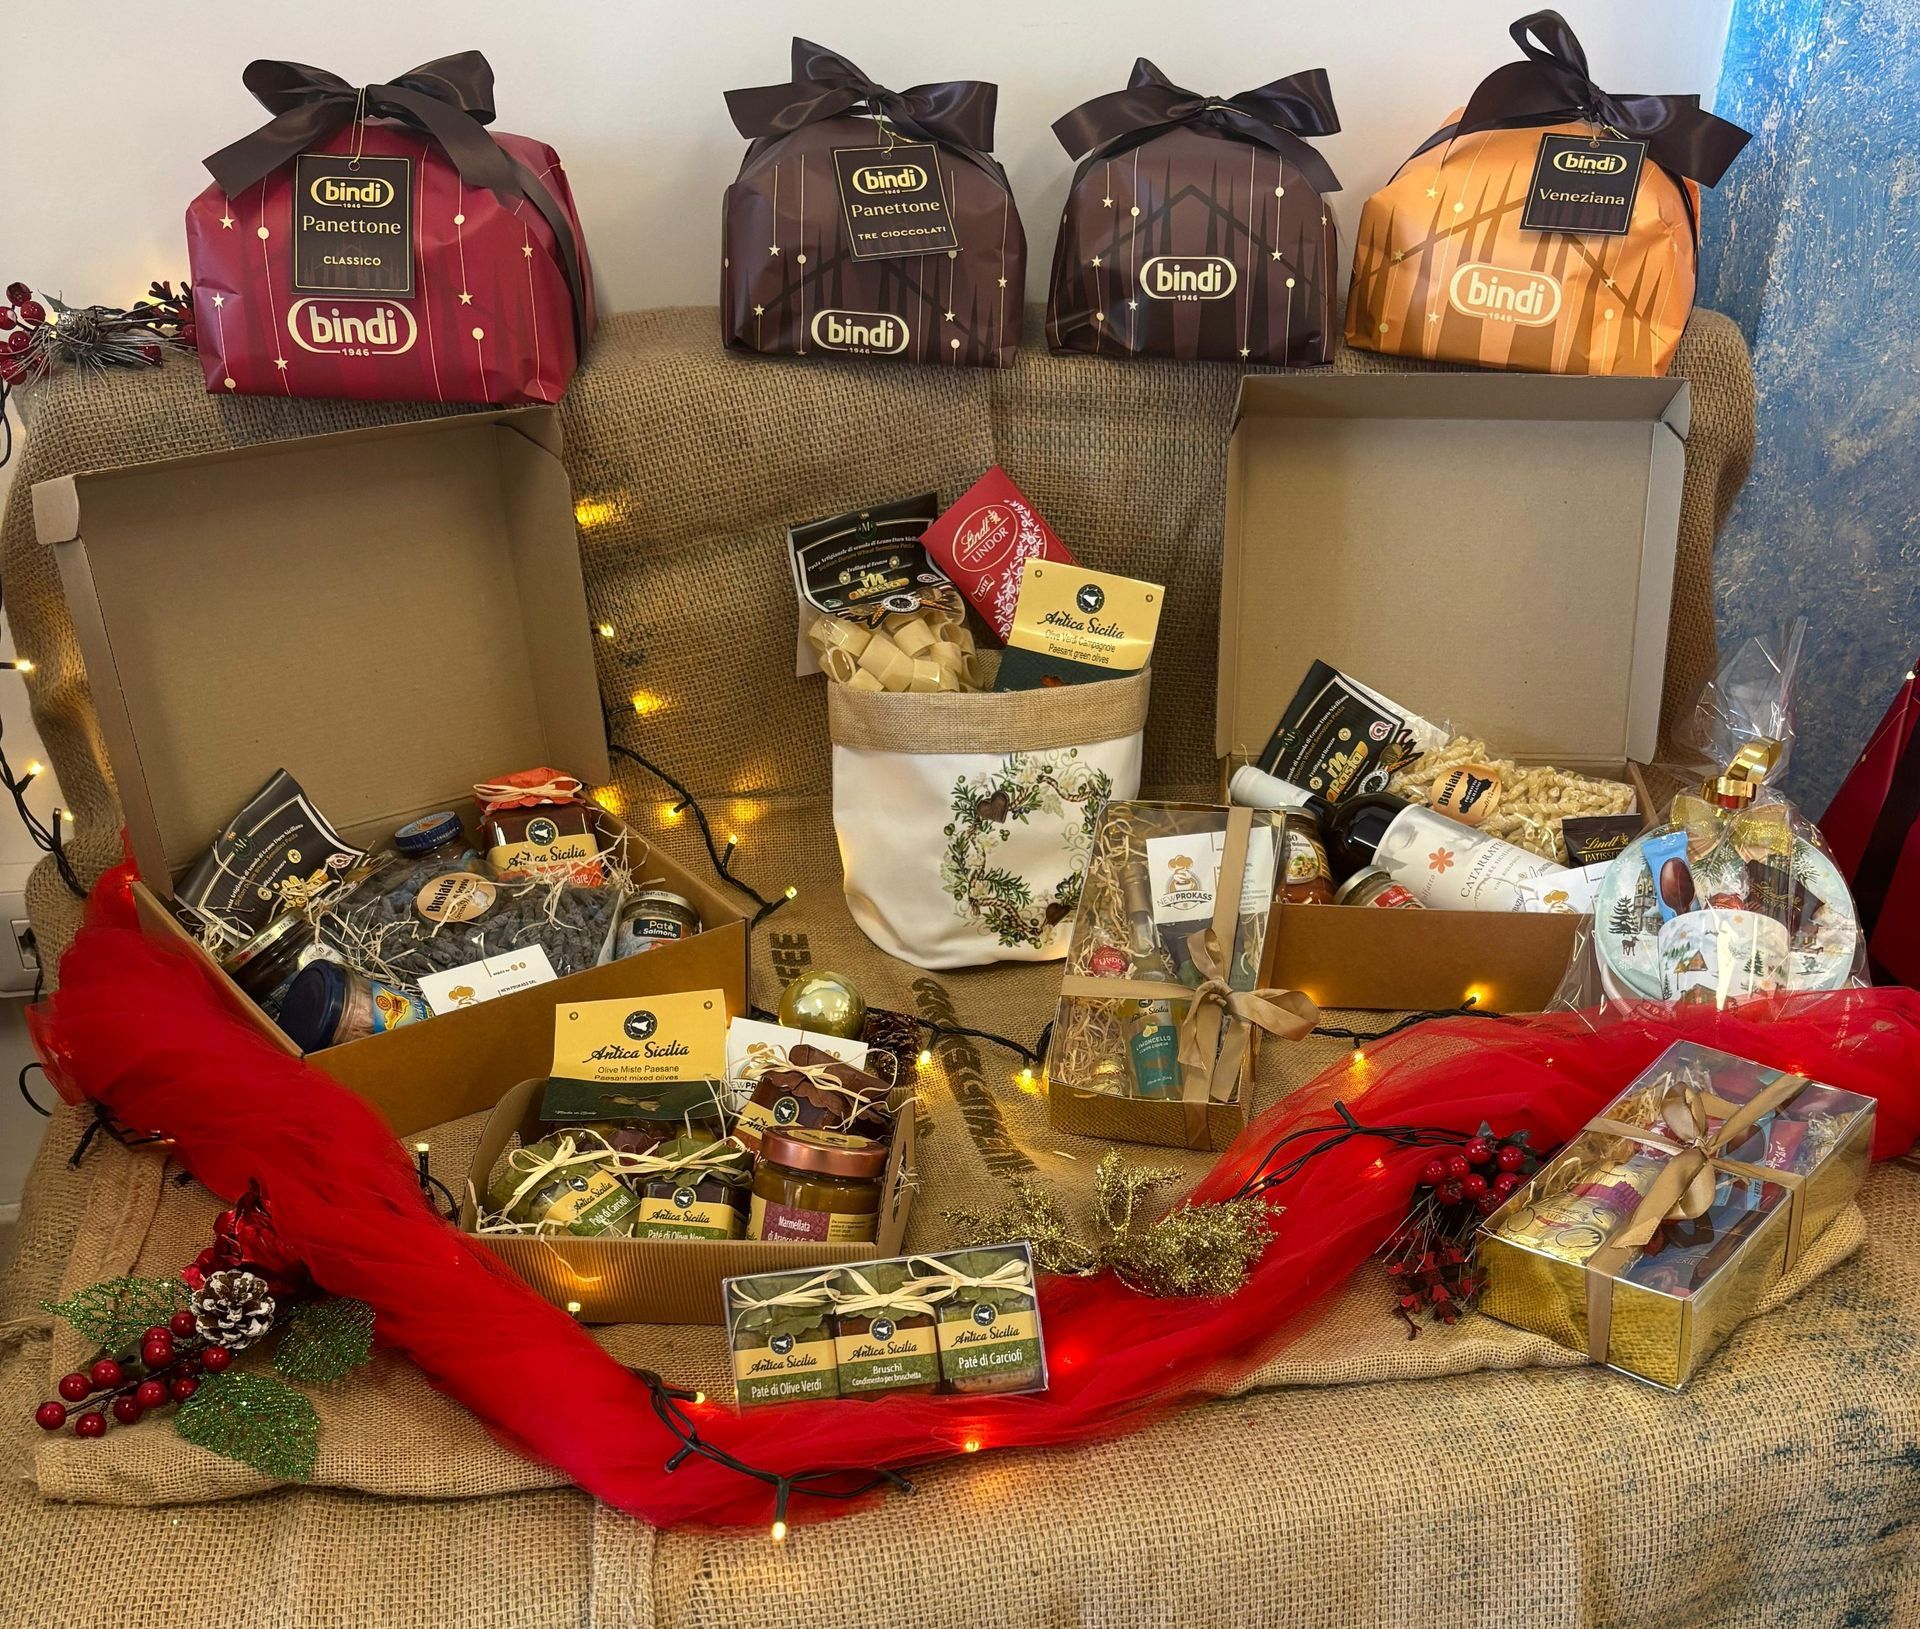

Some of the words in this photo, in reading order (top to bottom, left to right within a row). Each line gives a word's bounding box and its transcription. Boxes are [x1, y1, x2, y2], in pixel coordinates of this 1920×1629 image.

[1565, 153, 1616, 171] bindi
[864, 168, 917, 190] bindi
[325, 180, 381, 203] bindi
[1539, 188, 1625, 205] Veneziana
[851, 201, 940, 218] Panettone
[303, 215, 401, 235] Panettone
[858, 232, 878, 241] TRE
[881, 226, 947, 238] CIOCCOLATI
[323, 255, 381, 266] CLASSICO
[1156, 263, 1222, 292] bindi
[1467, 271, 1546, 315] bindi
[308, 306, 399, 345] bindi
[1489, 312, 1513, 322] 1946
[827, 319, 895, 348] bindi
[341, 348, 371, 357] 1946
[849, 346, 870, 355] 1946
[961, 516, 991, 553] Lindt
[971, 526, 1009, 564] LINDOR
[978, 580, 989, 597] LATTE
[1037, 611, 1084, 631] Antica
[1086, 617, 1125, 640] Sicilia
[1073, 648, 1091, 660] green
[1091, 651, 1110, 664] olives
[1322, 752, 1348, 778] in
[1330, 751, 1364, 793] Pasta
[1585, 835, 1619, 849] Lindt
[549, 844, 587, 861] Sicilia
[426, 879, 456, 912] Busiata
[643, 927, 677, 938] Salmone
[582, 1044, 640, 1063] Antica
[643, 1040, 690, 1058] Sicilia
[597, 1066, 619, 1074] Olive
[620, 1065, 642, 1073] Miste
[645, 1065, 680, 1073] Paesane
[647, 1209, 681, 1221] Antica
[683, 1210, 710, 1223] Sicilia
[778, 1216, 811, 1232] Marmellata
[950, 1330, 987, 1347] Antica
[989, 1325, 1021, 1340] Sicilia
[848, 1345, 885, 1361] Antica
[887, 1340, 918, 1354] Sicilia
[958, 1355, 978, 1369] Paté
[979, 1354, 989, 1366] di
[990, 1349, 1023, 1365] Carciofi
[746, 1359, 785, 1375] Antica
[786, 1354, 818, 1368] Sicilia
[852, 1376, 885, 1386] Condimento
[884, 1375, 894, 1384] per
[893, 1371, 922, 1381] bruschetta
[751, 1384, 769, 1398] Paté
[770, 1383, 779, 1396] di
[780, 1382, 800, 1395] Olive
[801, 1379, 822, 1392] Verdi
